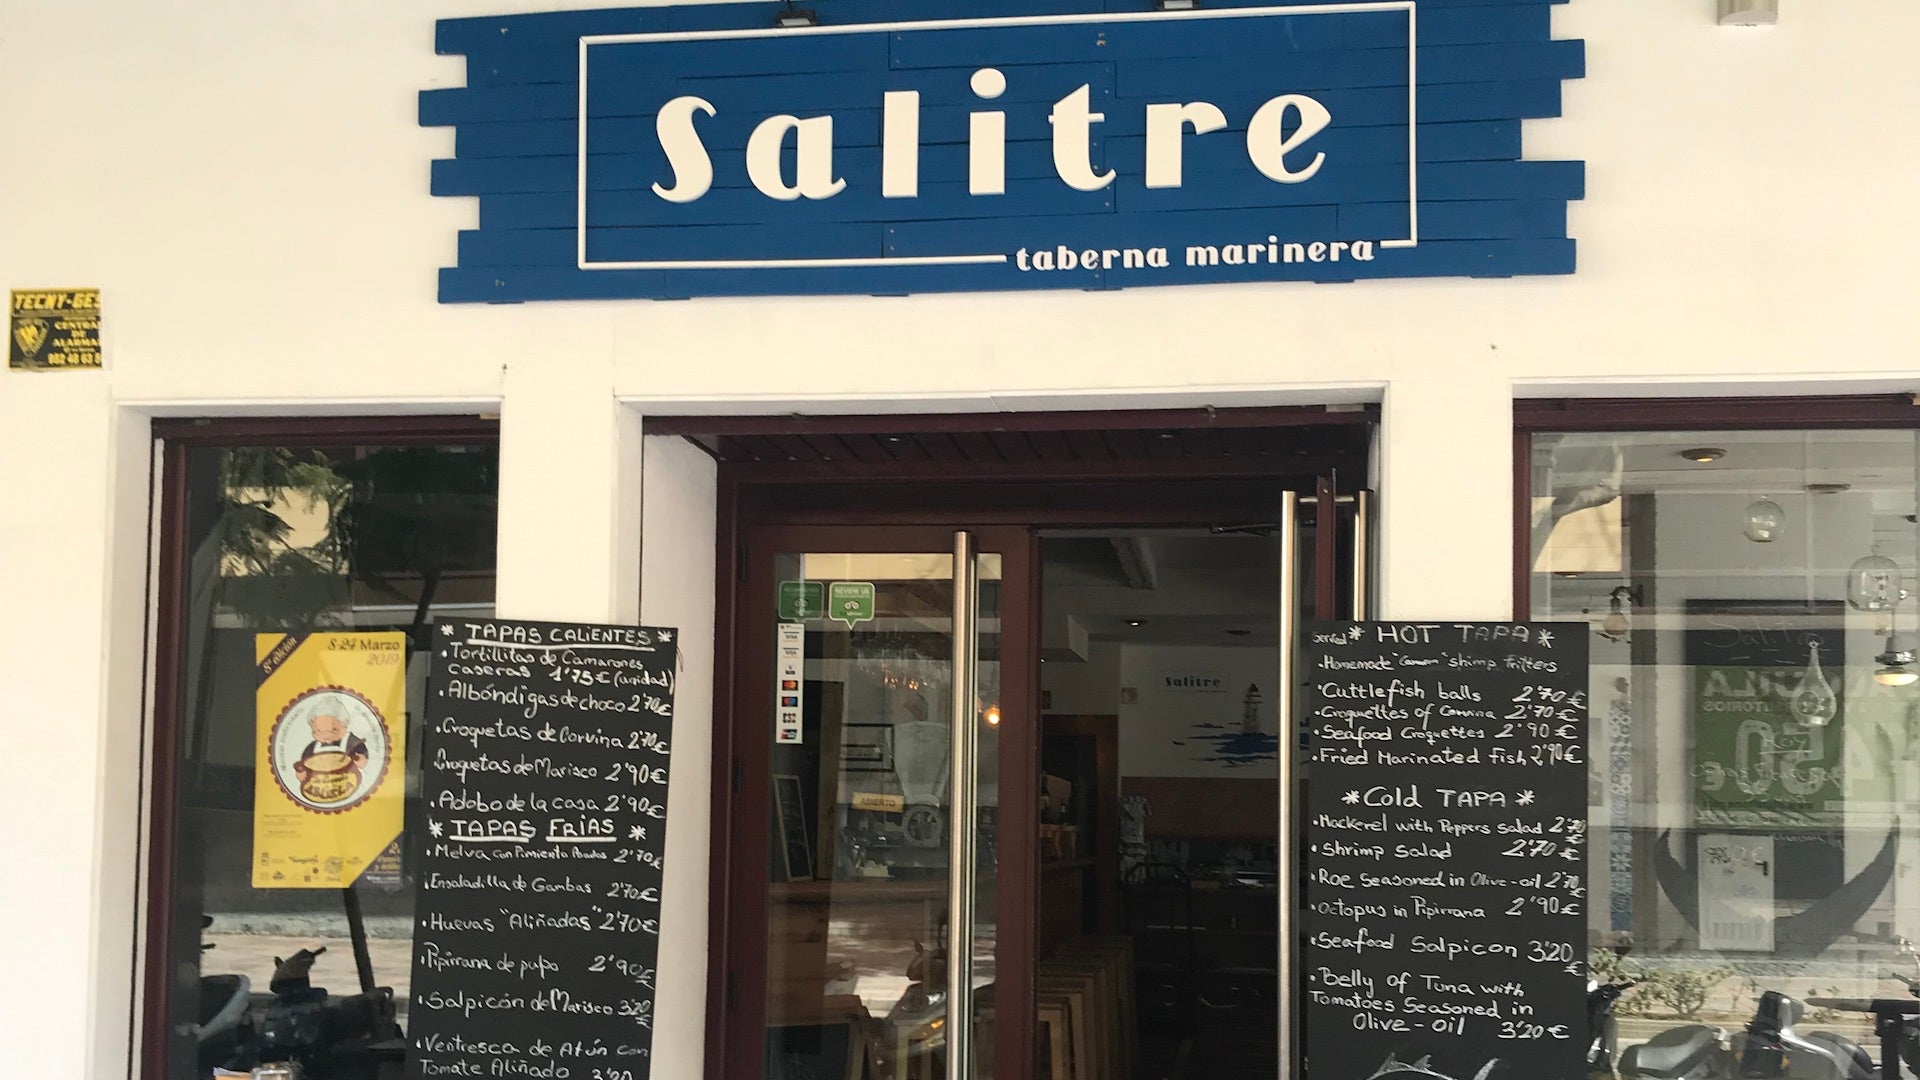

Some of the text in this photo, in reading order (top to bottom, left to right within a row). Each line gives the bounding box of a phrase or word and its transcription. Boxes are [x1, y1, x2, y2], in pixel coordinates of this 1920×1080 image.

[650, 67, 1331, 204] Salitre
[1015, 233, 1376, 272] taberna marinera
[360, 639, 401, 651] Marzo
[465, 623, 542, 644] TAPAS
[1377, 624, 1530, 643] HOT TAPA
[367, 654, 400, 666] 2019
[450, 641, 643, 670] Tortillitas de Camarones
[614, 669, 674, 695] (unidad)
[1165, 675, 1221, 688] Salitre
[1321, 679, 1425, 708] Cuttlefish
[1437, 681, 1482, 702] balls
[448, 679, 559, 719] Albóndigas
[560, 688, 579, 708] de
[579, 693, 626, 712] choco
[1320, 704, 1409, 729] Croquettes
[1414, 703, 1436, 731] of
[443, 716, 533, 748] Croquetas
[537, 721, 557, 742] de
[560, 725, 624, 749] Corvina
[1321, 724, 1393, 749] Seafood
[513, 753, 533, 776] de
[534, 757, 598, 778] Marisco
[1320, 747, 1369, 765] Fried
[439, 788, 503, 813] Adobo
[506, 793, 525, 812] de
[530, 792, 548, 813] la
[1363, 783, 1506, 808] Cold TAPA
[450, 819, 537, 838] TAPAS
[1395, 818, 1434, 834] with
[435, 844, 491, 861] Melva
[1394, 841, 1452, 860] Salad
[430, 872, 511, 891] Ensaladilla
[512, 874, 527, 892] de
[531, 876, 592, 894] Gambas
[1318, 867, 1355, 889] Roe
[1359, 870, 1447, 888] Seasoned
[1449, 873, 1465, 887] in
[430, 912, 495, 932] Huevas
[1393, 904, 1408, 919] in
[1317, 927, 1395, 955] Seafood
[1410, 935, 1518, 961] Salpicon
[496, 952, 516, 973] de
[1317, 966, 1525, 999] Belly of Tuna with
[530, 990, 550, 1011] de
[550, 988, 613, 1015] Marisco
[1309, 990, 1534, 1020] Tomatoes Seasoned in
[424, 1033, 521, 1054] Ventresca
[528, 1038, 552, 1058] de
[560, 1038, 608, 1058] Atún
[419, 1058, 484, 1077] Tomate
[491, 1058, 570, 1079] Aliñado
